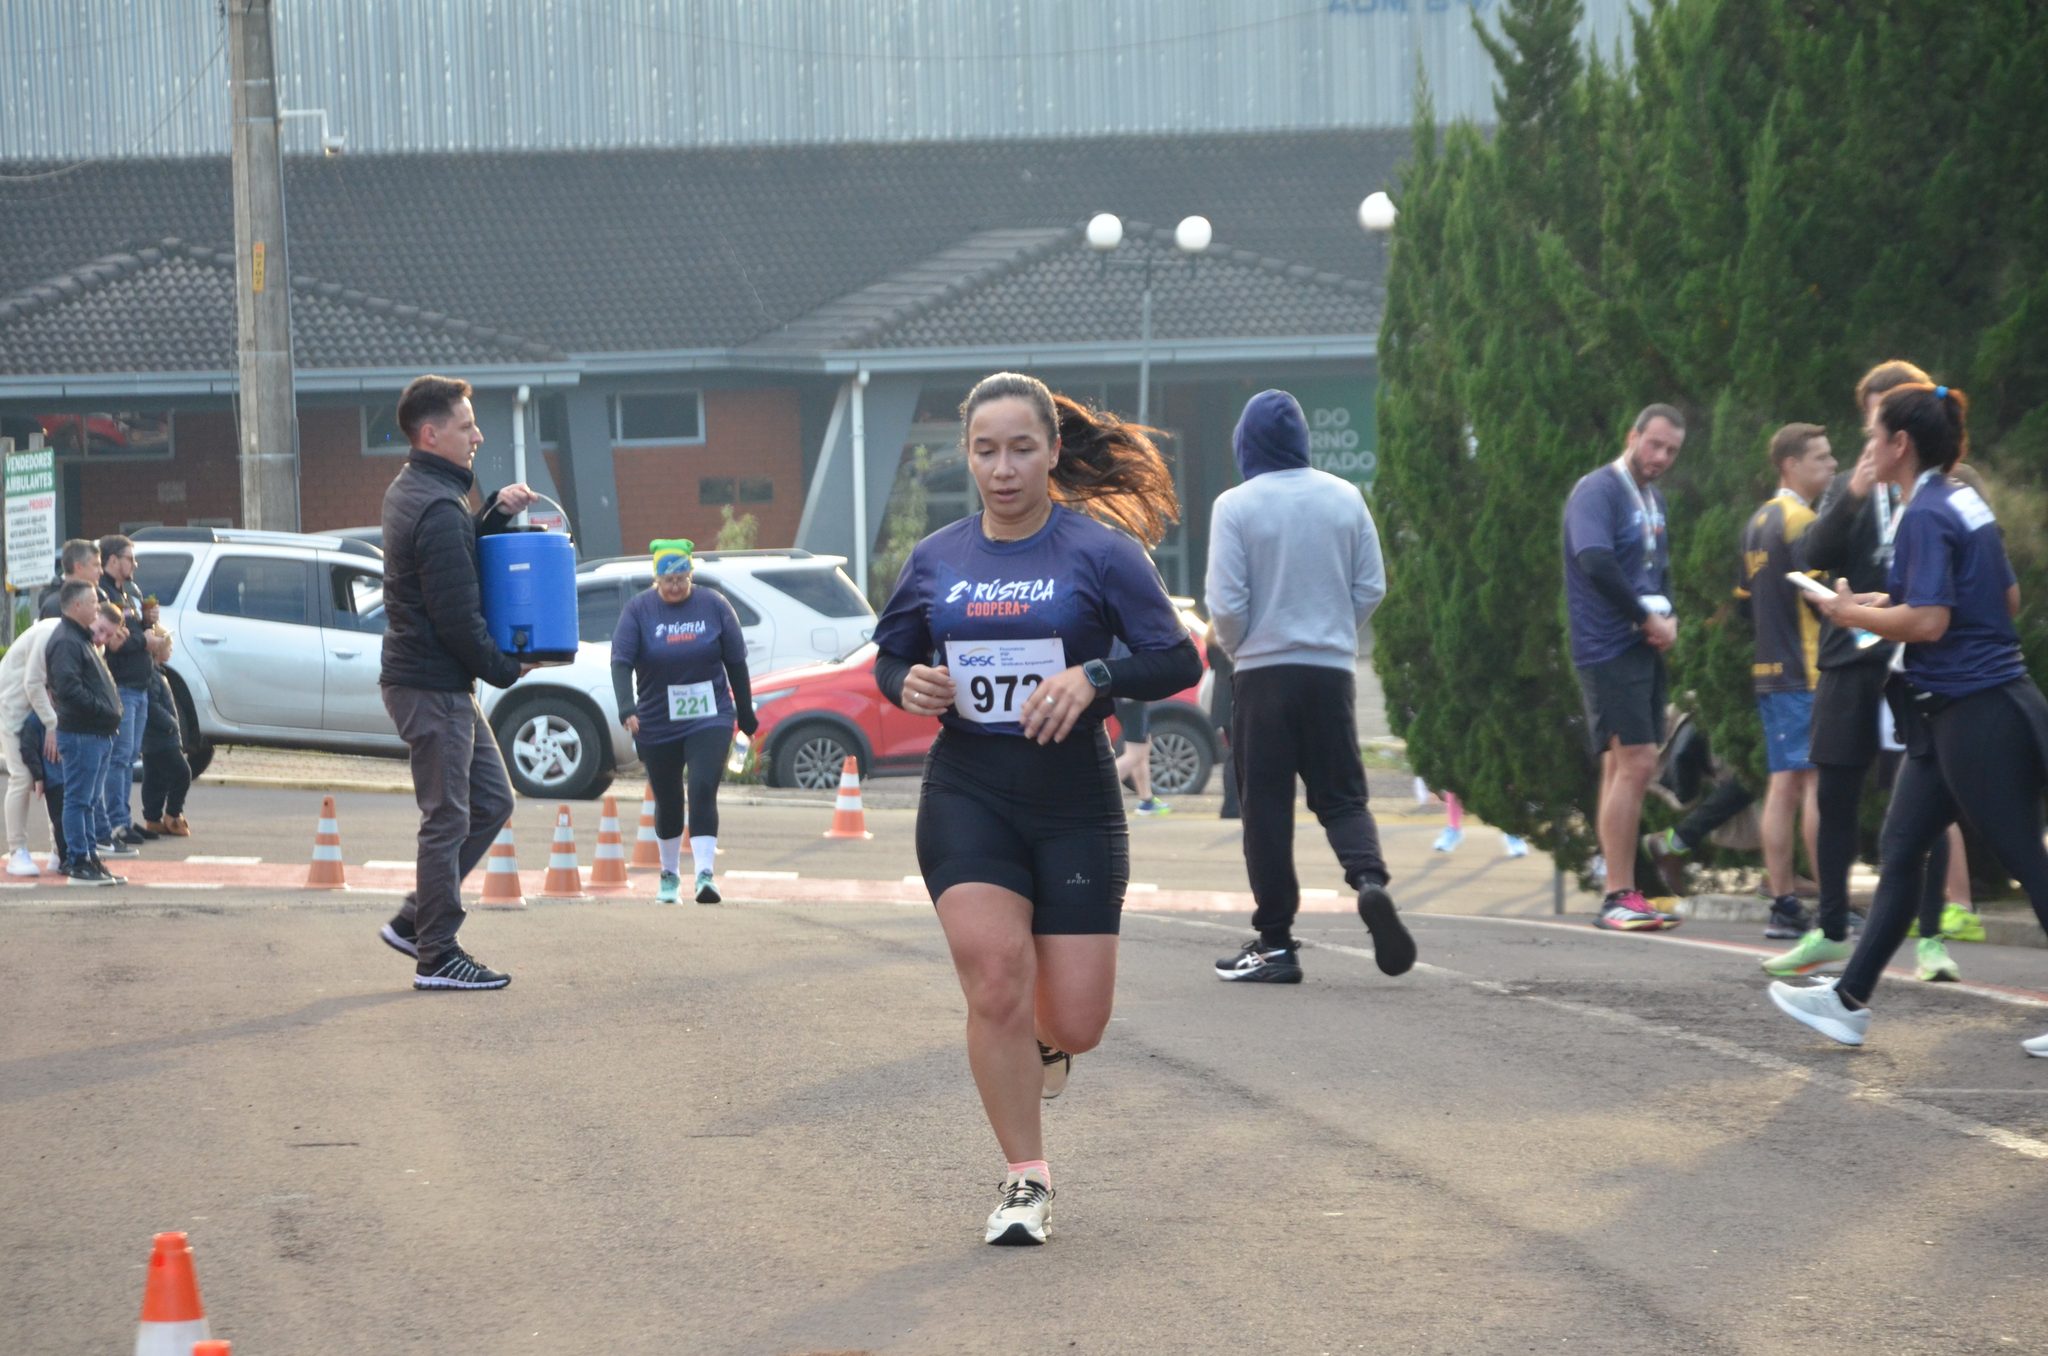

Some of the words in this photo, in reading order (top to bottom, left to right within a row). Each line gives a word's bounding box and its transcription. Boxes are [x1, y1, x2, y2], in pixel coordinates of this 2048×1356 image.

[1314, 408, 1349, 427] DO
[5, 451, 53, 472] VENDEDORES
[5, 471, 53, 492] AMBULANTES
[973, 578, 1055, 601] RÚSTICA
[966, 601, 1031, 617] COOPERA+
[675, 694, 709, 716] 221
